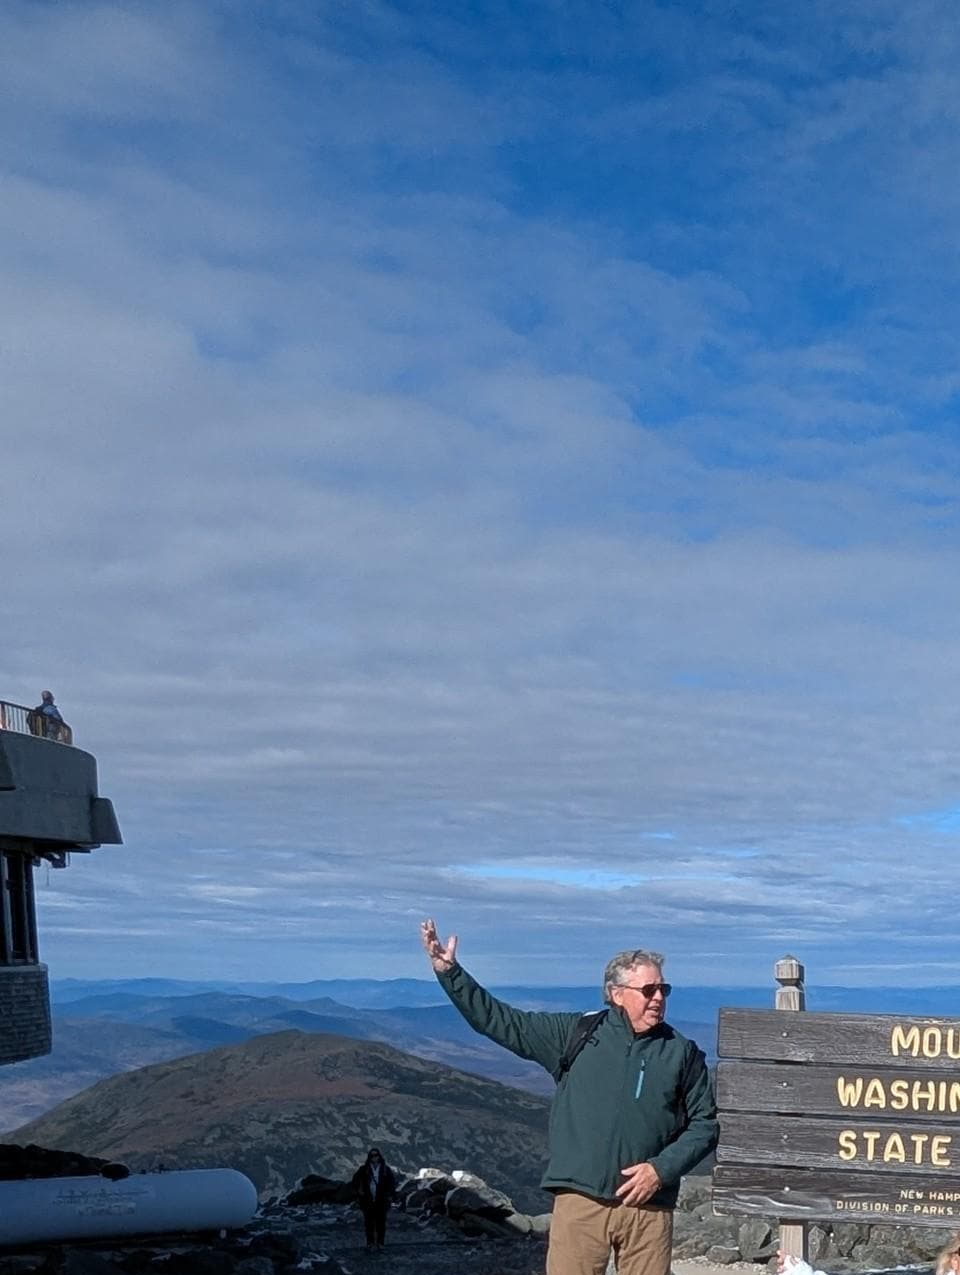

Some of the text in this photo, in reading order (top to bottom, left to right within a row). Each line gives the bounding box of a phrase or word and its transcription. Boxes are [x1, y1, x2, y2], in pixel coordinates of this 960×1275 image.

[838, 1129, 951, 1166] STATE
[900, 1190, 923, 1199] NEW
[836, 1200, 889, 1212] DIVISION
[895, 1204, 908, 1213] OF
[913, 1204, 953, 1216] PARKS
